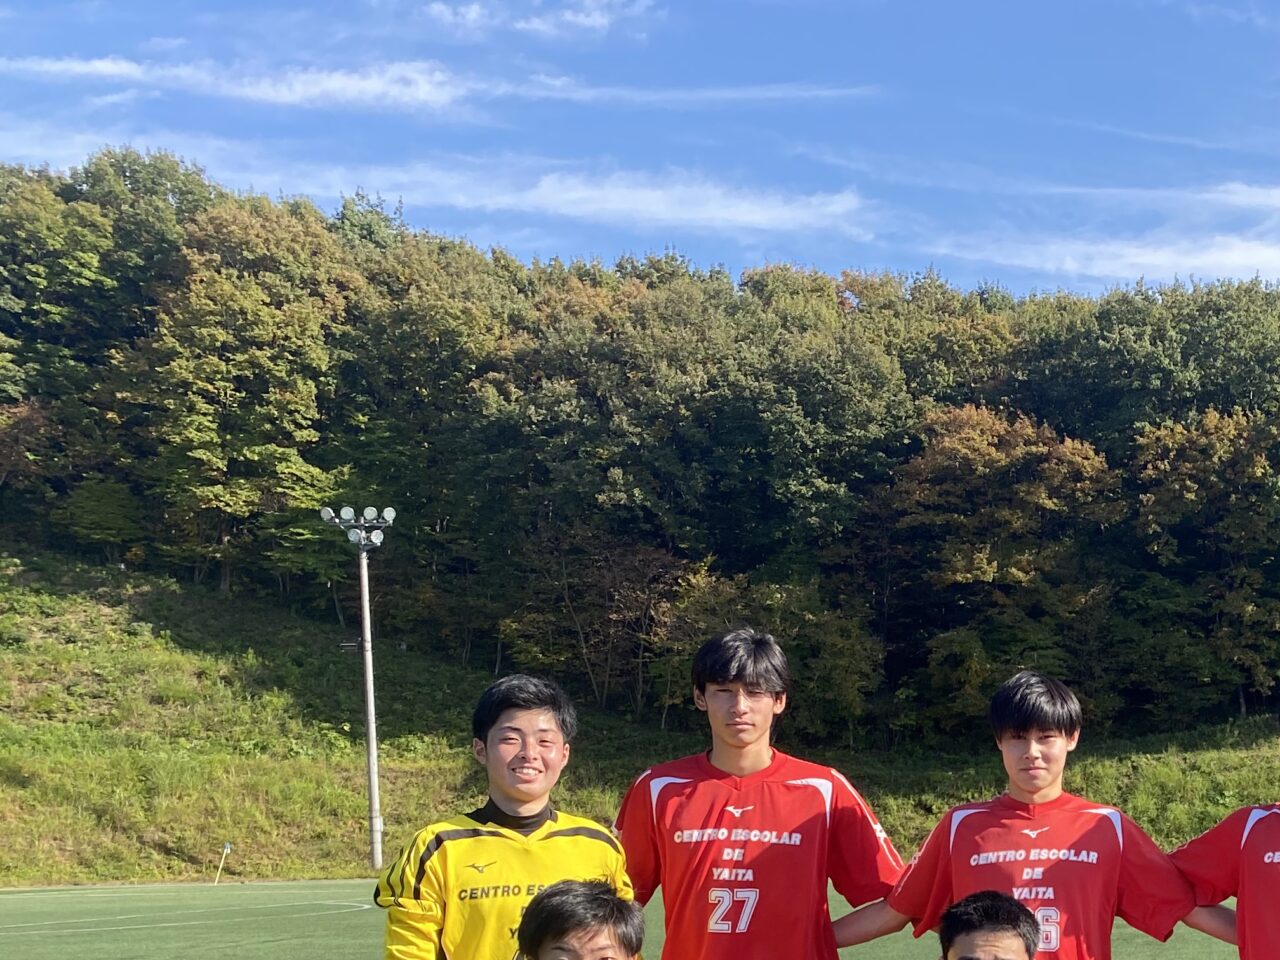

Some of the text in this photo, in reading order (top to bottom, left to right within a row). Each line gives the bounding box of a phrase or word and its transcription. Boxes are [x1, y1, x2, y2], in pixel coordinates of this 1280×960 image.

[674, 828, 802, 845] CENTRO ESCOLAR
[722, 848, 744, 861] DE
[970, 848, 1098, 866] CENTRO ESCOLAR
[712, 867, 753, 881] YAITA
[1022, 867, 1045, 880] DE
[458, 884, 521, 901] CENTRO
[1012, 887, 1055, 899] YAITA
[707, 887, 760, 933] 27
[1027, 906, 1061, 952] 6
